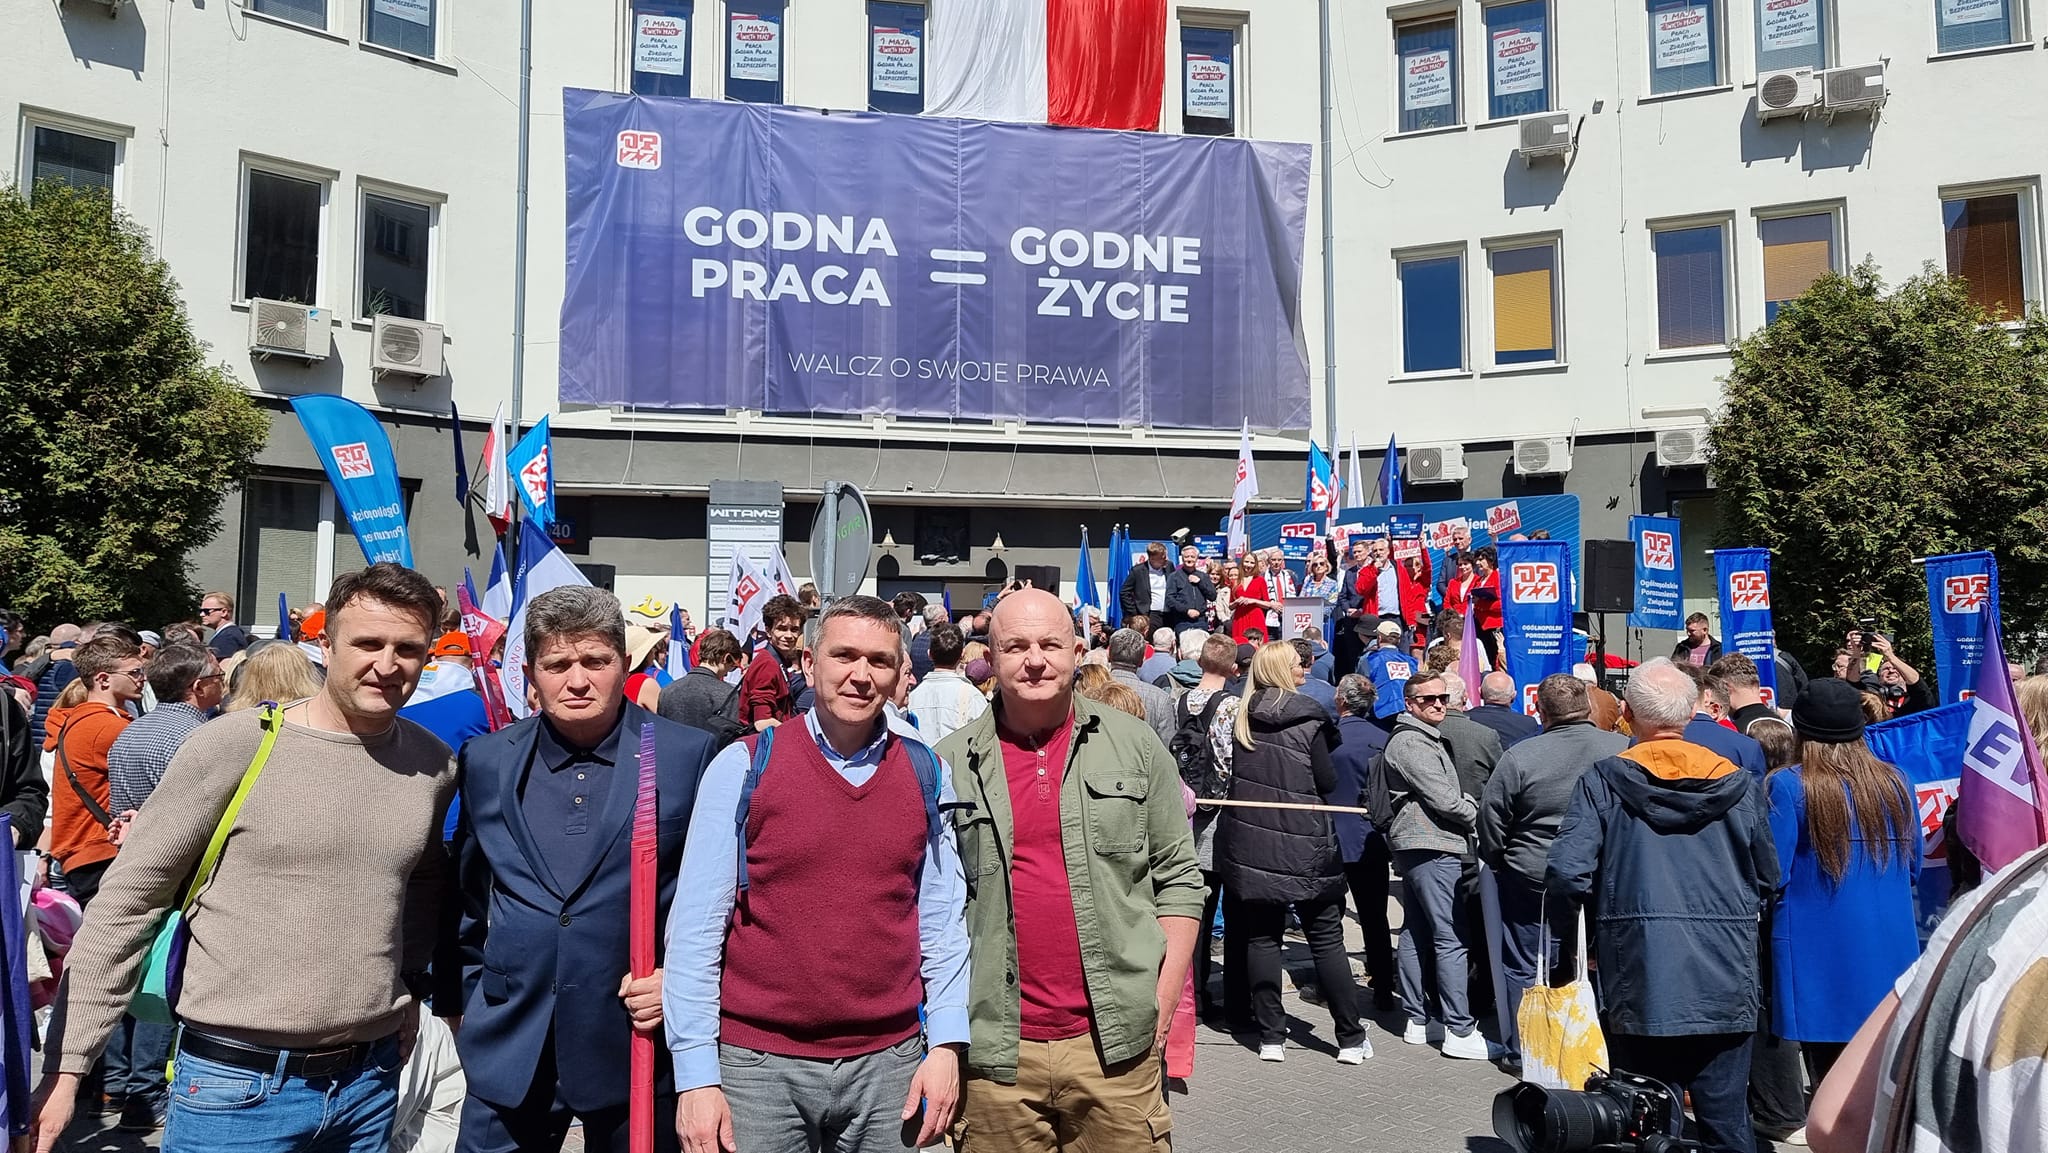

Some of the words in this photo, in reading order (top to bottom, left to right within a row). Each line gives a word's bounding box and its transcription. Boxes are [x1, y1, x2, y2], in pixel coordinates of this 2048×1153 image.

[1672, 9, 1696, 20] MAJA
[1509, 36, 1531, 47] MAJA
[1419, 55, 1440, 64] MAJA
[684, 207, 899, 257] GODNA
[1010, 226, 1202, 275] GODNE
[691, 258, 892, 307] PRACA
[1037, 265, 1190, 323] ŻYCIE
[788, 352, 883, 377] WALCZ
[890, 357, 911, 378] O
[918, 359, 1009, 383] SWOJE
[1017, 363, 1111, 387] PRAWA
[710, 508, 780, 518] WITAMY
[552, 524, 570, 538] 40
[1438, 536, 1453, 546] LEW
